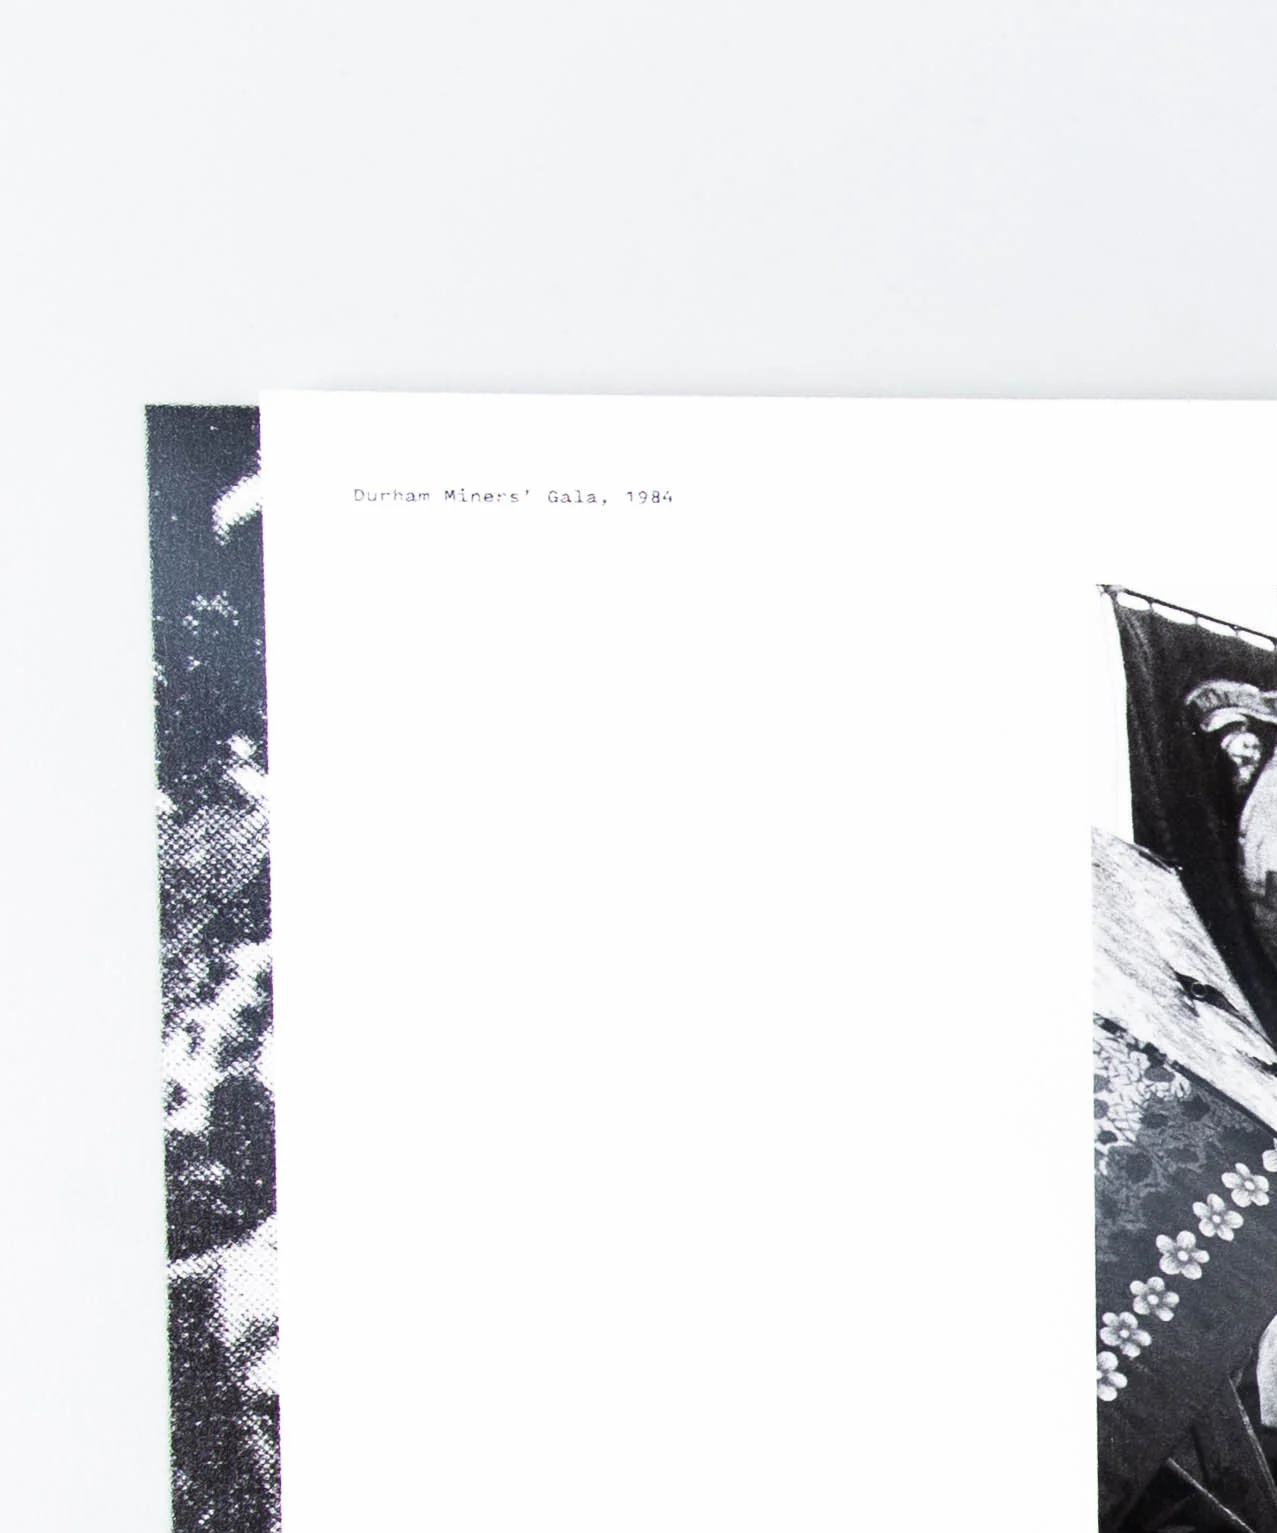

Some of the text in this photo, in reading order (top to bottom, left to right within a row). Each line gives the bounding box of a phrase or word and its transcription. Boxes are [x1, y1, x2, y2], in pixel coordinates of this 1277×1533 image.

[353, 488, 431, 502] Durham
[547, 489, 608, 506] Gala,
[626, 490, 674, 504] 1984
